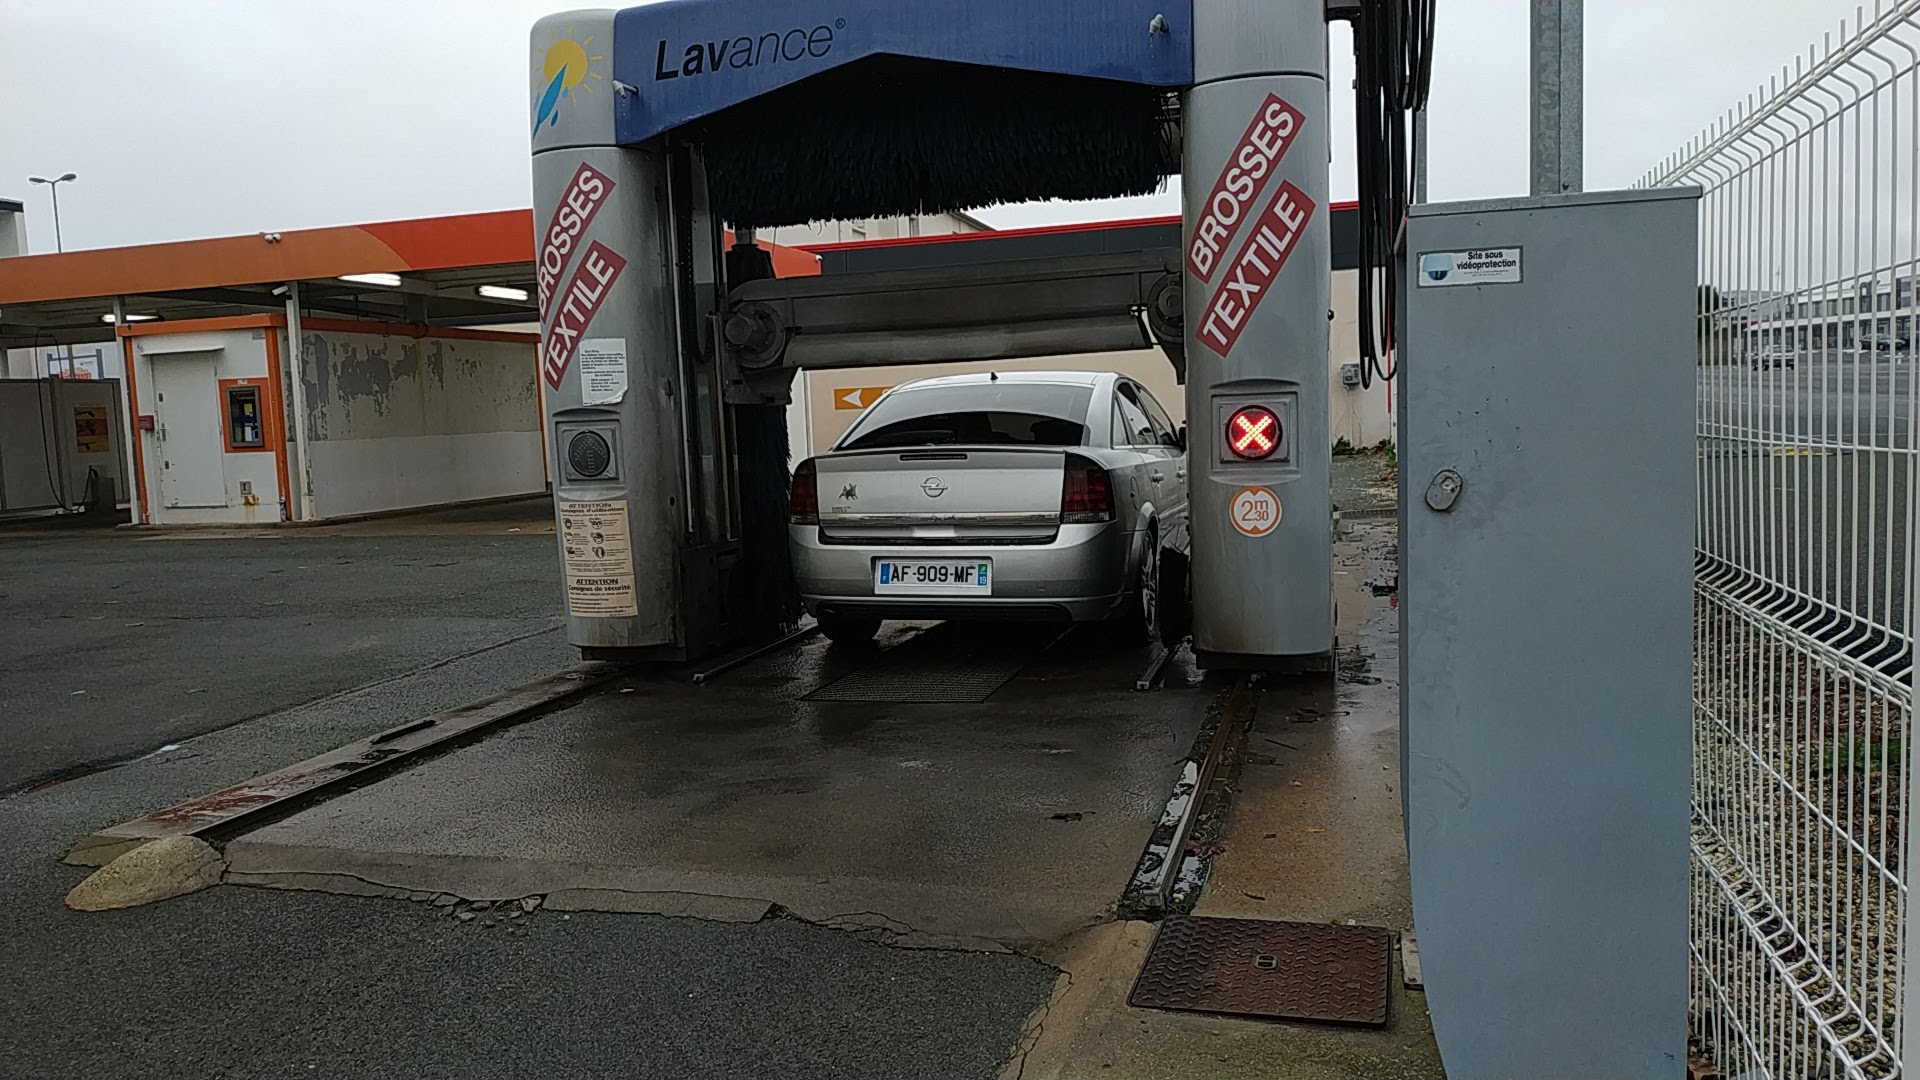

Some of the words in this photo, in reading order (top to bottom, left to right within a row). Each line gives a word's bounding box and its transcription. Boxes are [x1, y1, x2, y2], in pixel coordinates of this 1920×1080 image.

[1191, 102, 1294, 276] BROSSES
[538, 169, 604, 317] BROSSES
[1202, 191, 1306, 346] TEXTILE
[1456, 259, 1516, 270] vidéoprotection
[1467, 251, 1483, 260] Site
[1484, 251, 1503, 259] sous
[544, 250, 615, 382] TEXTILE
[604, 584, 632, 592] sécurité
[890, 565, 976, 583] AF-909-MF
